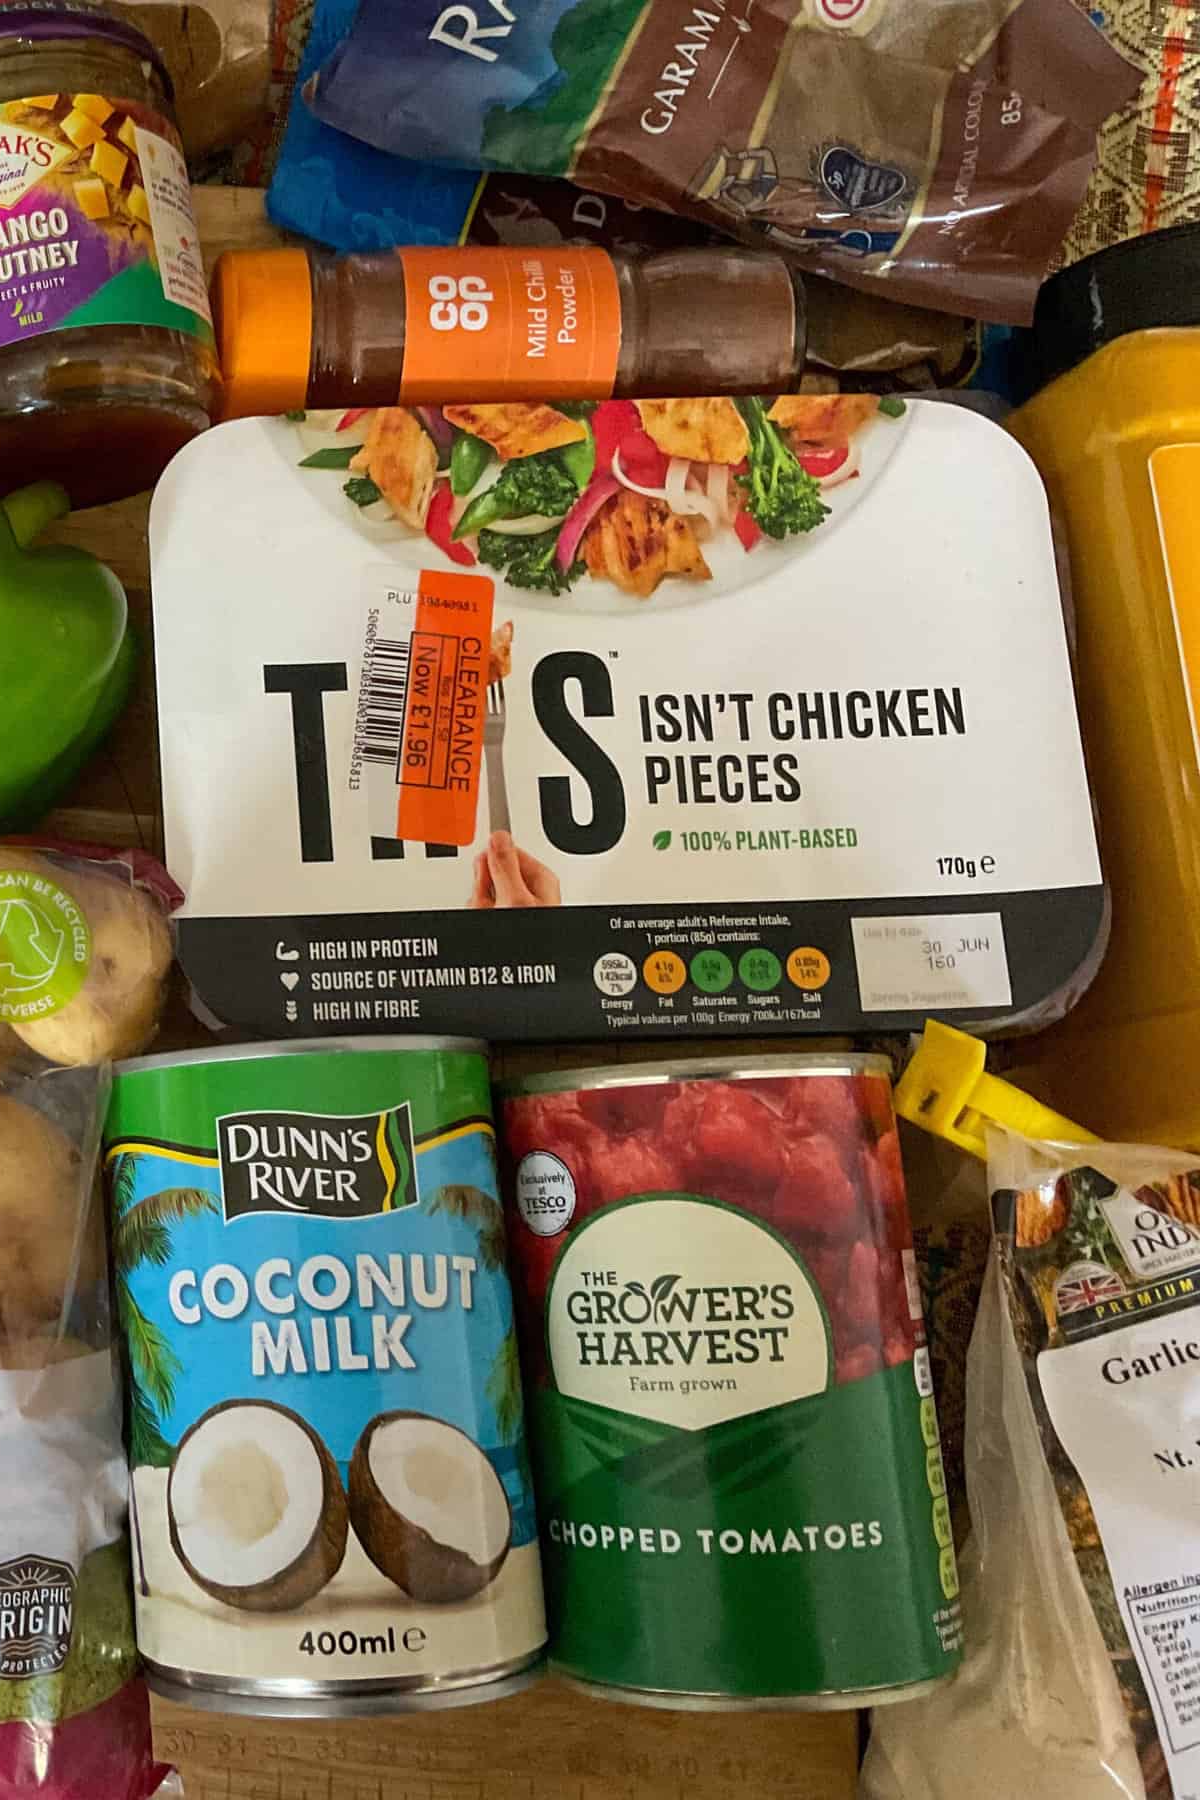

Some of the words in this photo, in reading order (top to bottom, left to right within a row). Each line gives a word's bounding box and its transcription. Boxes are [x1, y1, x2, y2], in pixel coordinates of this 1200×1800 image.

[640, 8, 721, 134] GARAM
[30, 276, 65, 293] FRUITY
[523, 258, 548, 304] Chilli
[19, 312, 44, 326] MILD
[557, 268, 577, 345] Powder
[527, 307, 548, 358] Mild
[387, 592, 412, 605] PLU
[412, 645, 437, 697] Now
[448, 637, 481, 793] CLEARANCE
[639, 693, 753, 743] ISN'T
[767, 687, 966, 741] CHICKEN
[405, 705, 432, 768] £1.96
[645, 753, 801, 804] PIECES
[680, 831, 732, 851] 100%
[736, 827, 858, 850] PLANT-BASED
[936, 857, 976, 878] 170g
[32, 879, 52, 896] BE
[53, 892, 86, 962] RECYCLED
[609, 917, 622, 929] Of
[623, 918, 636, 929] an
[637, 917, 675, 930] average
[676, 916, 708, 928] adult's
[709, 915, 758, 927] Reference
[308, 941, 349, 960] HIGH
[350, 940, 368, 959] IN
[371, 938, 439, 959] PROTEIN
[654, 932, 688, 946] portion
[690, 931, 716, 945] (85g)
[311, 970, 374, 991] SOURCE
[377, 969, 398, 988] OF
[400, 967, 467, 988] VITAMIN
[469, 966, 498, 985] B12
[501, 966, 515, 984] &
[517, 965, 557, 983] IRON
[312, 1000, 350, 1021] HIGH
[354, 1000, 371, 1019] IN
[374, 998, 420, 1019] FIBRE
[601, 998, 633, 1010] Energy
[658, 996, 674, 1008] Fat
[692, 996, 738, 1007] Saturates
[747, 994, 781, 1006] Sugars
[802, 992, 822, 1003] Salt
[606, 1014, 640, 1028] Typical
[641, 1013, 672, 1025] values
[673, 1014, 689, 1026] per
[718, 1011, 751, 1024] Energy
[228, 1122, 374, 1168] DUNN'S
[247, 1161, 361, 1211] RIVER
[524, 1196, 566, 1209] TESCO
[168, 1254, 477, 1324] COCONUT
[581, 1271, 618, 1287] THE
[567, 1278, 795, 1324] GROWER'S
[1095, 1278, 1194, 1318] PREMIUM
[250, 1314, 417, 1377] MILK
[579, 1328, 789, 1366] HARVEST
[1100, 1337, 1200, 1386] Garlic
[629, 1376, 675, 1393] Farm
[680, 1376, 738, 1396] grown
[550, 1518, 681, 1554] CHOPPED
[696, 1520, 883, 1555] TOMATOES
[1123, 1579, 1178, 1598] Allergen
[298, 1627, 396, 1658] 400ml
[1144, 1618, 1186, 1635] Energy
[0, 1643, 68, 1673] PROTECTED
